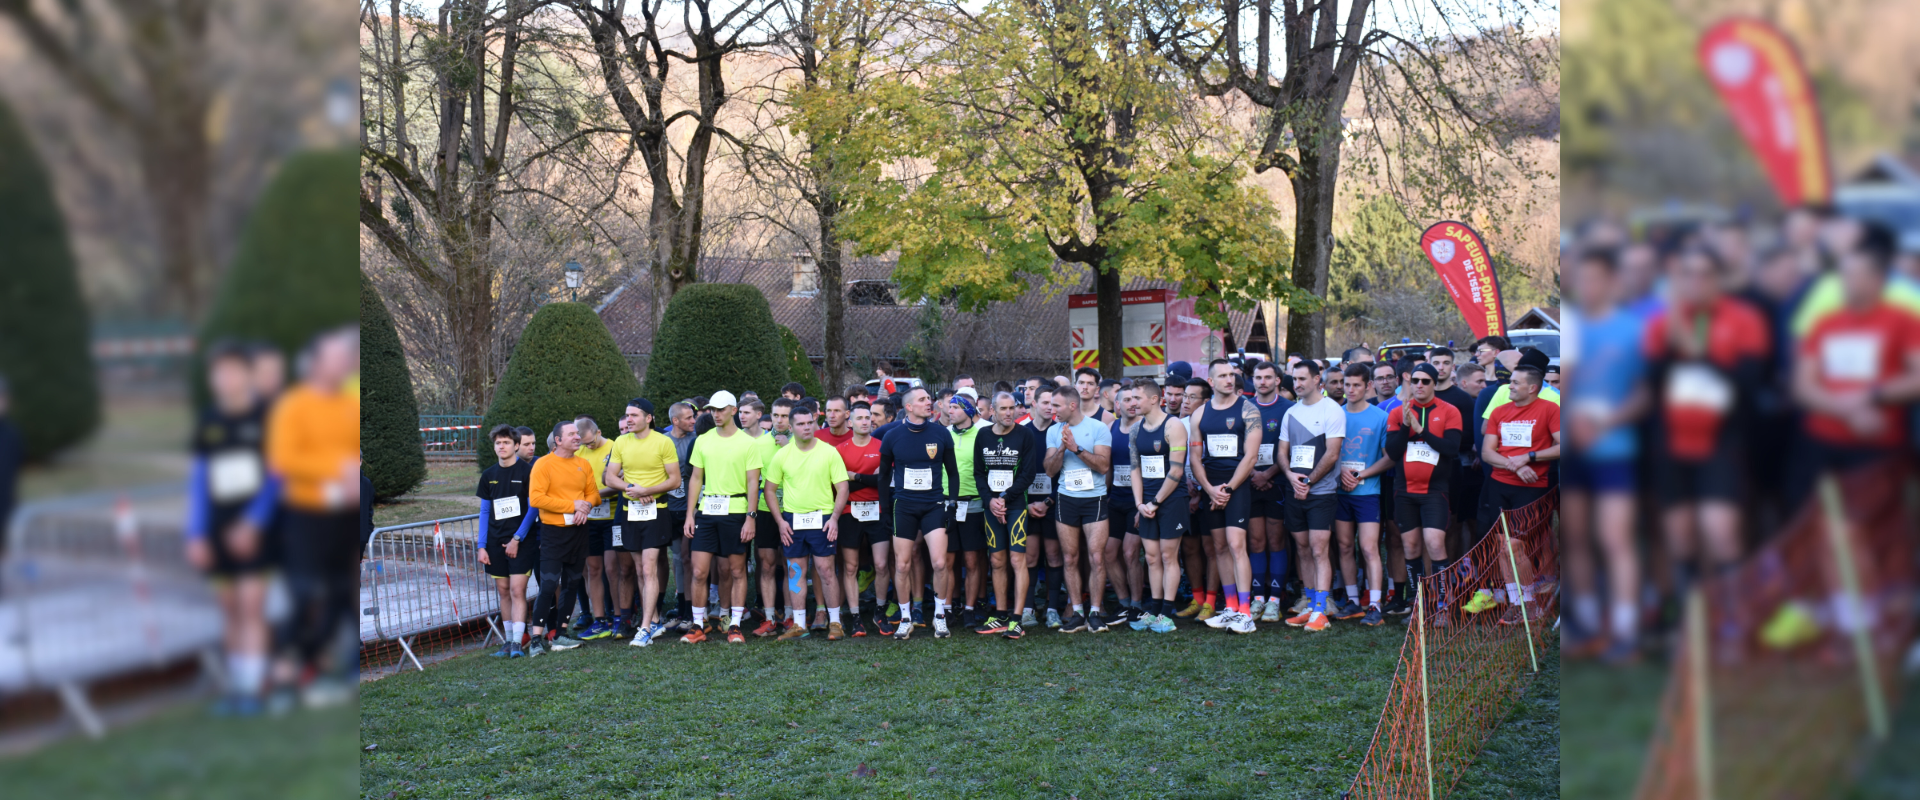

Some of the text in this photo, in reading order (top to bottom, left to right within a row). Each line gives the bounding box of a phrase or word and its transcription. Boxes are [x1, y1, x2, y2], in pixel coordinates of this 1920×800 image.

[1445, 226, 1500, 336] SAPEURS-POMPIERS
[1462, 259, 1482, 303] DE L'ISÈRE
[501, 506, 513, 514] 803
